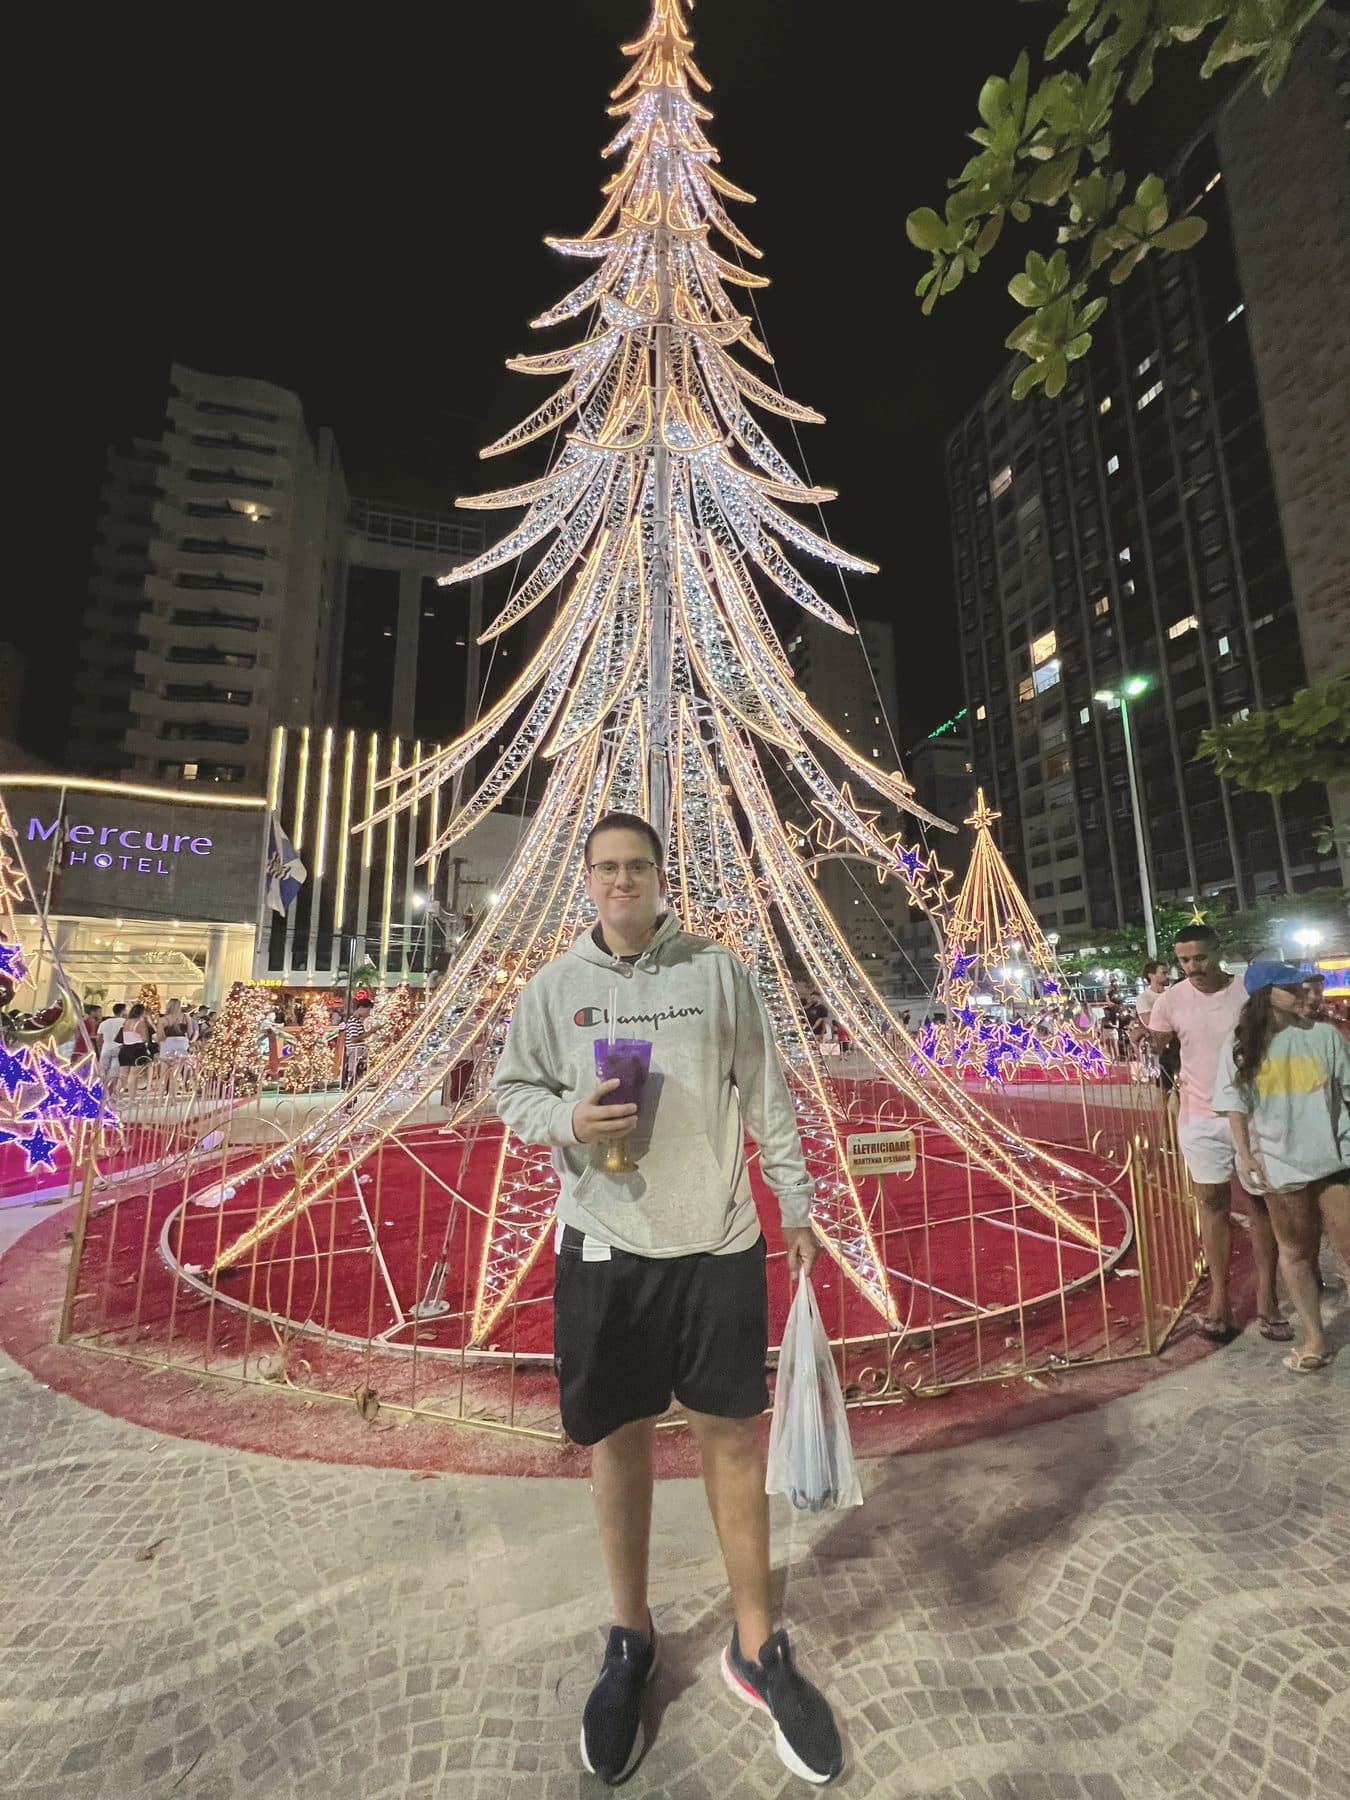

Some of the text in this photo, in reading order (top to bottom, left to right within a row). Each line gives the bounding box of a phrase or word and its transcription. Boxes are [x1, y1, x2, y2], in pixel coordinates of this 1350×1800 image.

[27, 817, 213, 855] Mercure
[70, 851, 169, 874] HOTEL
[853, 1140, 911, 1155] ELETRICIDADE
